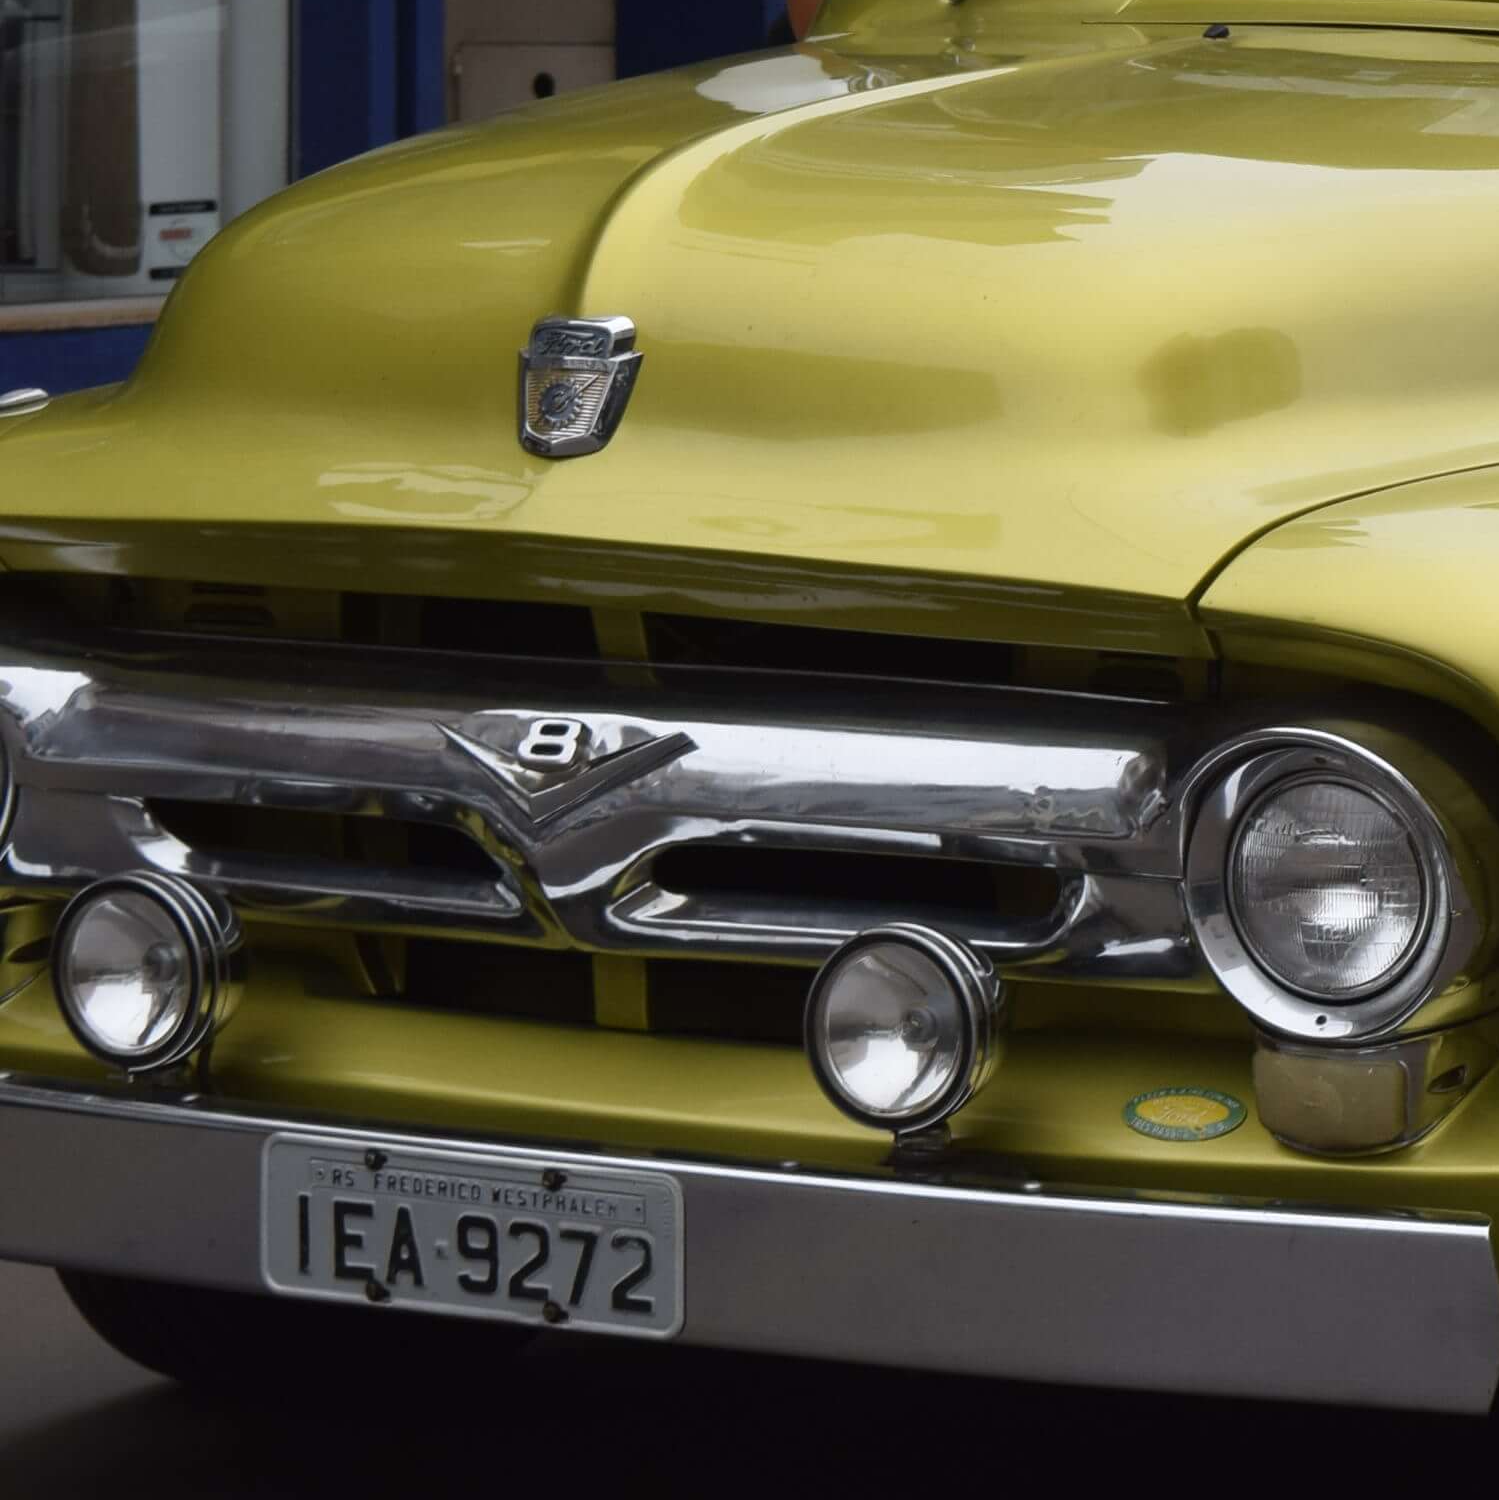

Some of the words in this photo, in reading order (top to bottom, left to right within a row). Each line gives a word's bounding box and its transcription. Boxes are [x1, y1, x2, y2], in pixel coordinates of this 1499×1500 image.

[331, 1169, 356, 1190] RS
[373, 1171, 483, 1202] FREDERICO
[490, 1184, 619, 1218] WESTPHALEN
